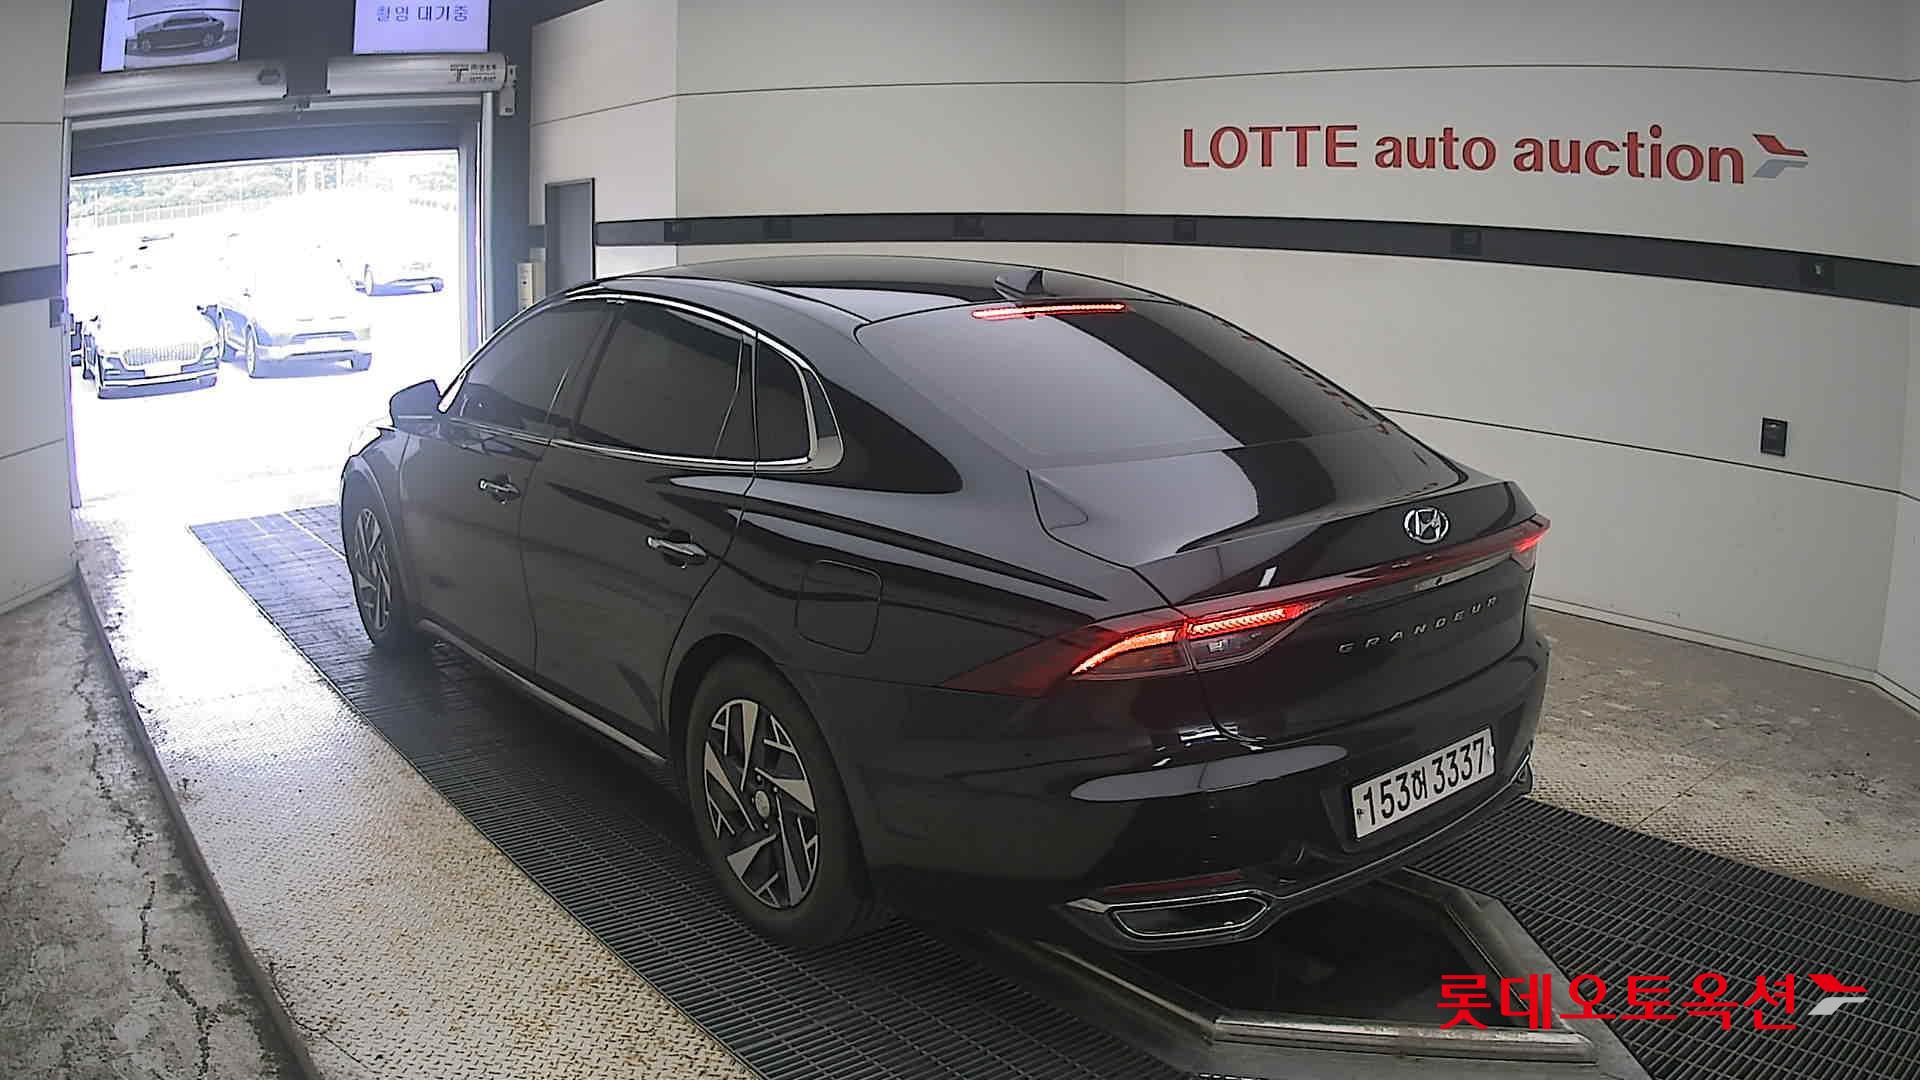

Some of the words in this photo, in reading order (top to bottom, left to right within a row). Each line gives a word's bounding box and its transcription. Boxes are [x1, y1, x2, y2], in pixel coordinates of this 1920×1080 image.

[1183, 124, 1358, 169] LOTTE
[1374, 127, 1497, 171] auto
[1513, 124, 1745, 184] auction
[1337, 595, 1498, 655] GRANDEUR
[1431, 737, 1485, 795] 3337
